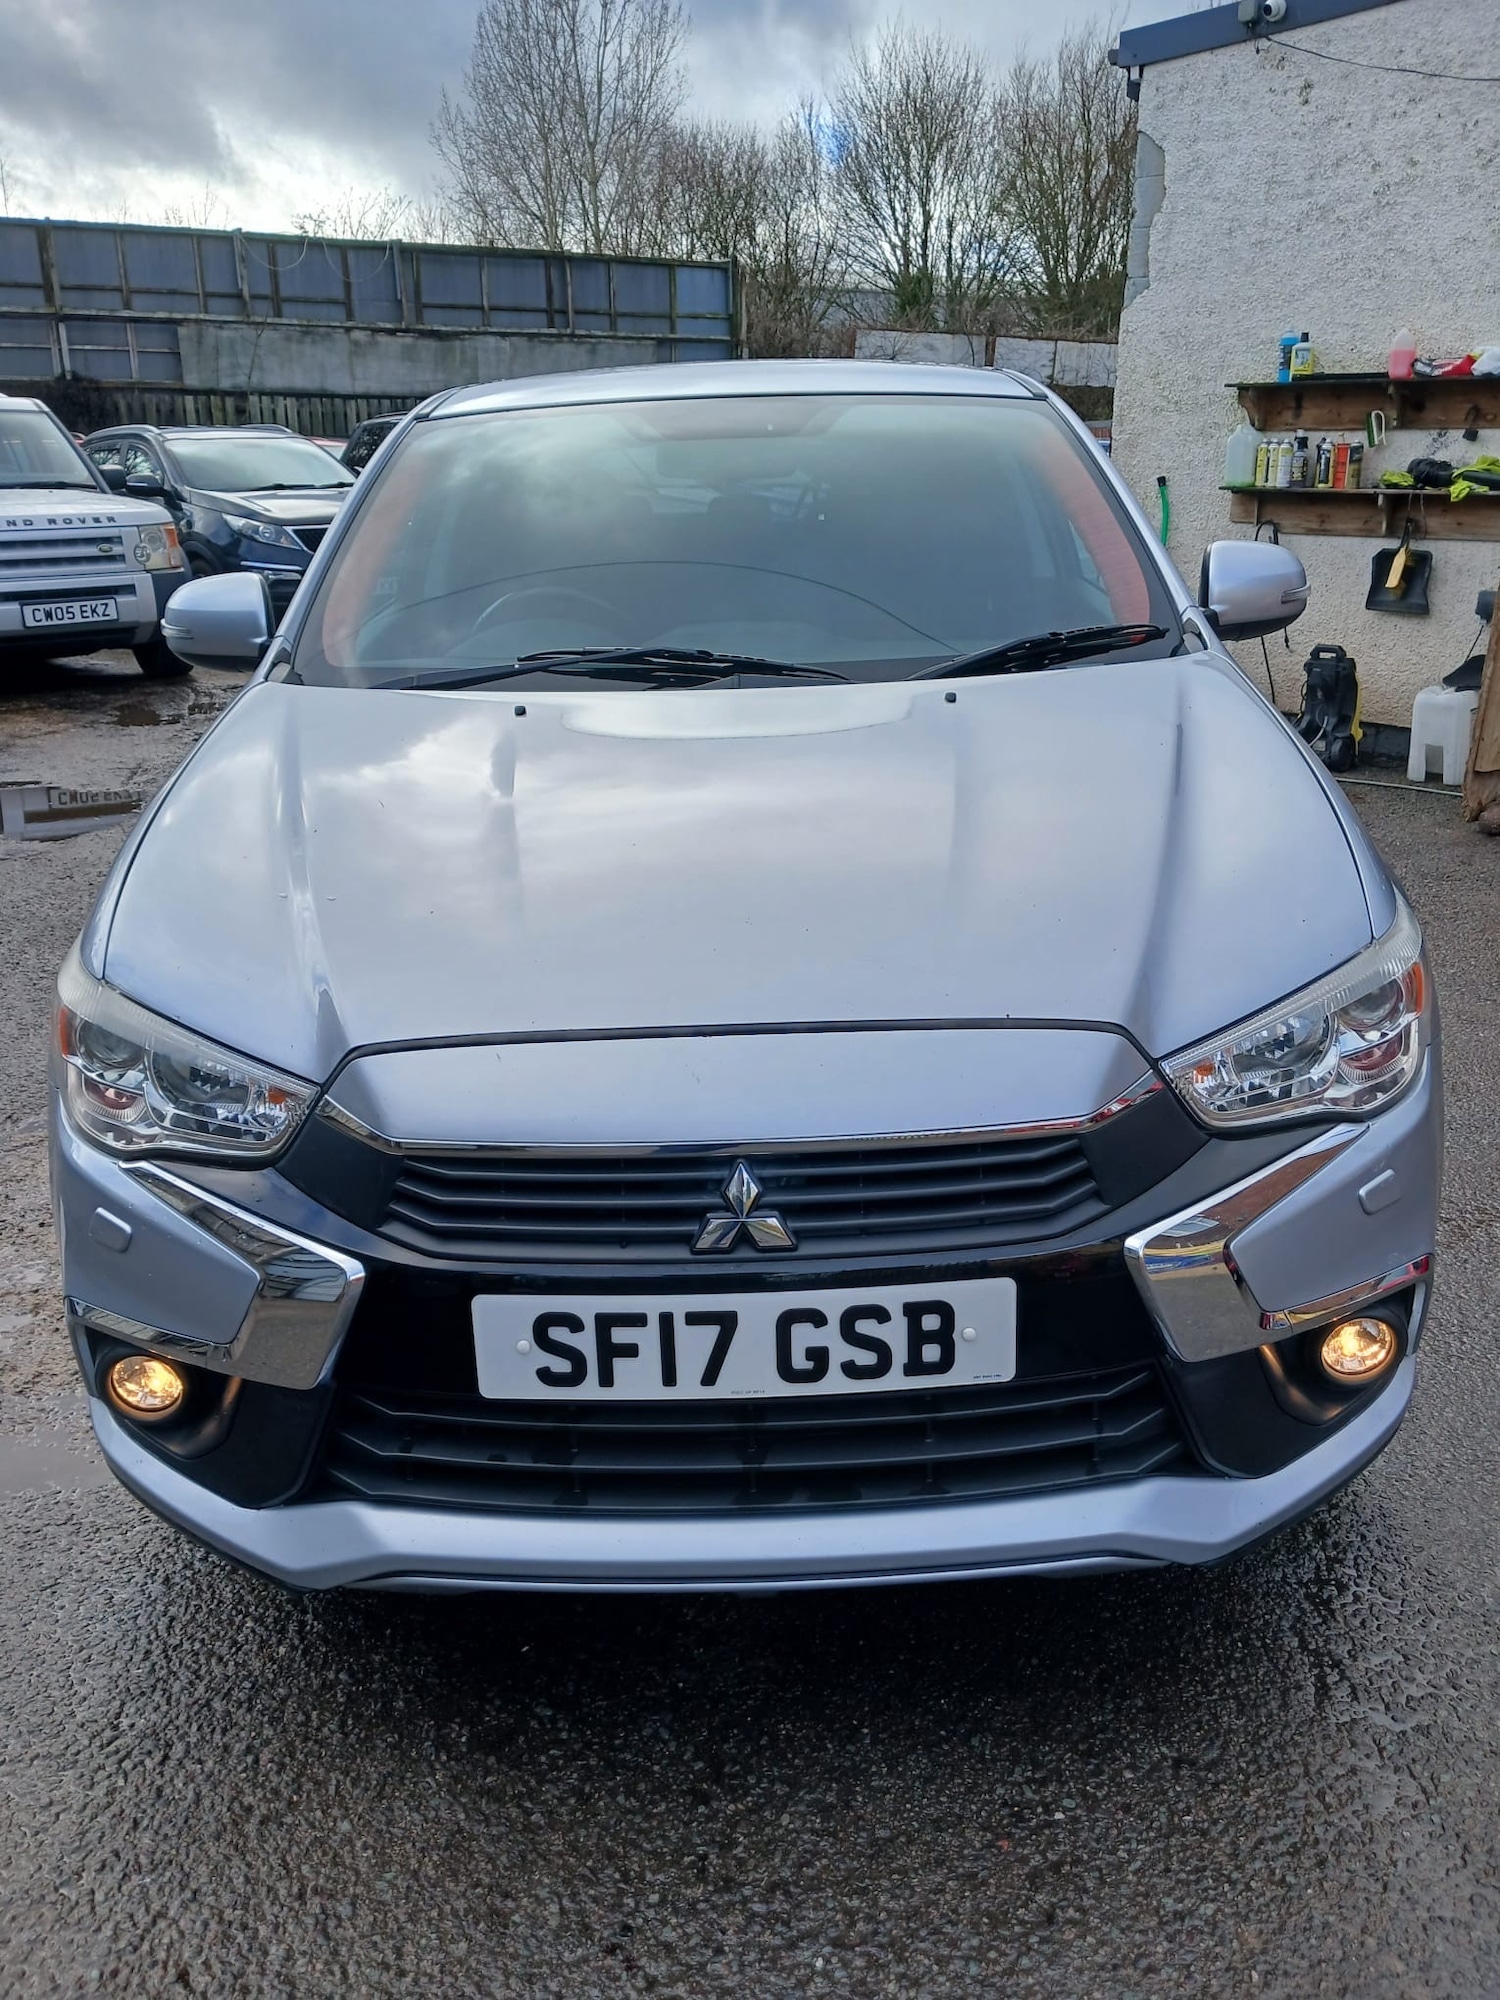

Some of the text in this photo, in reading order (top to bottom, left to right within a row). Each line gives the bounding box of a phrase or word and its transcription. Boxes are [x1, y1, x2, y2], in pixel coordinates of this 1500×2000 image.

[46, 516, 117, 525] ROVER
[32, 602, 111, 623] CW05 EKZ
[532, 1299, 956, 1388] SF17 GSB
